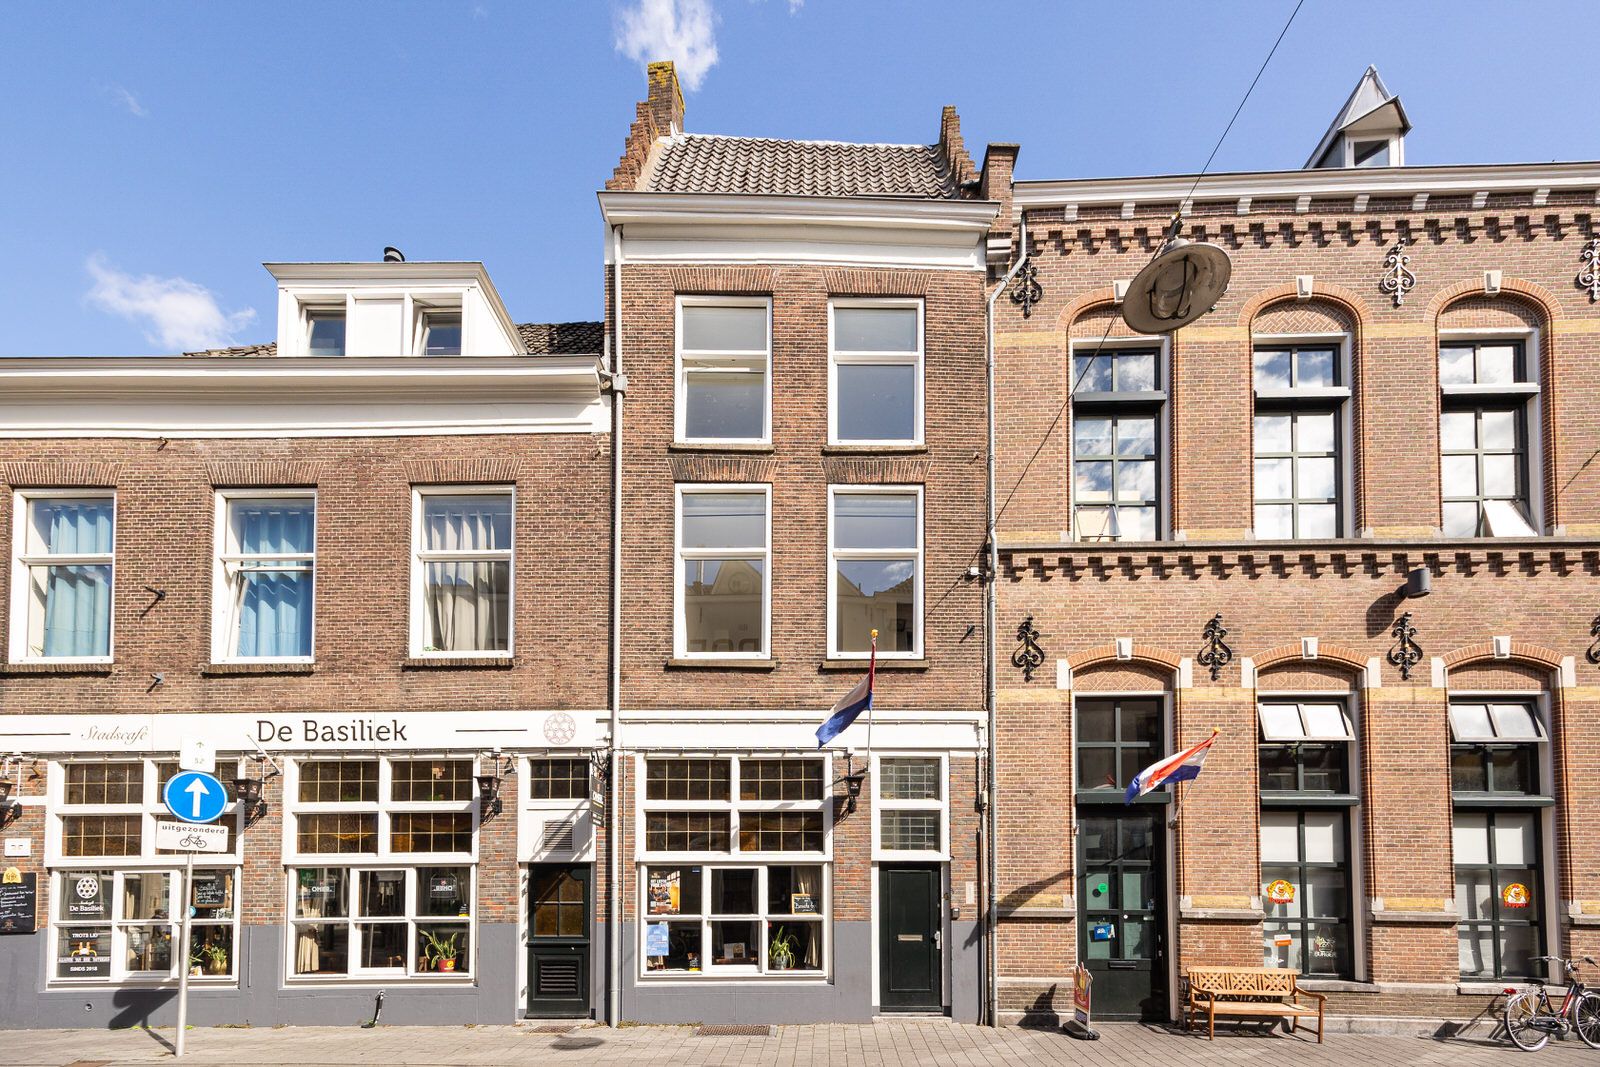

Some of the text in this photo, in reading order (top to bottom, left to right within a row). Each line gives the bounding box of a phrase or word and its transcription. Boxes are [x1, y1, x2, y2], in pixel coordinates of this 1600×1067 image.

[256, 719, 408, 742] De Basiliek
[162, 824, 225, 835] uitgezonderd
